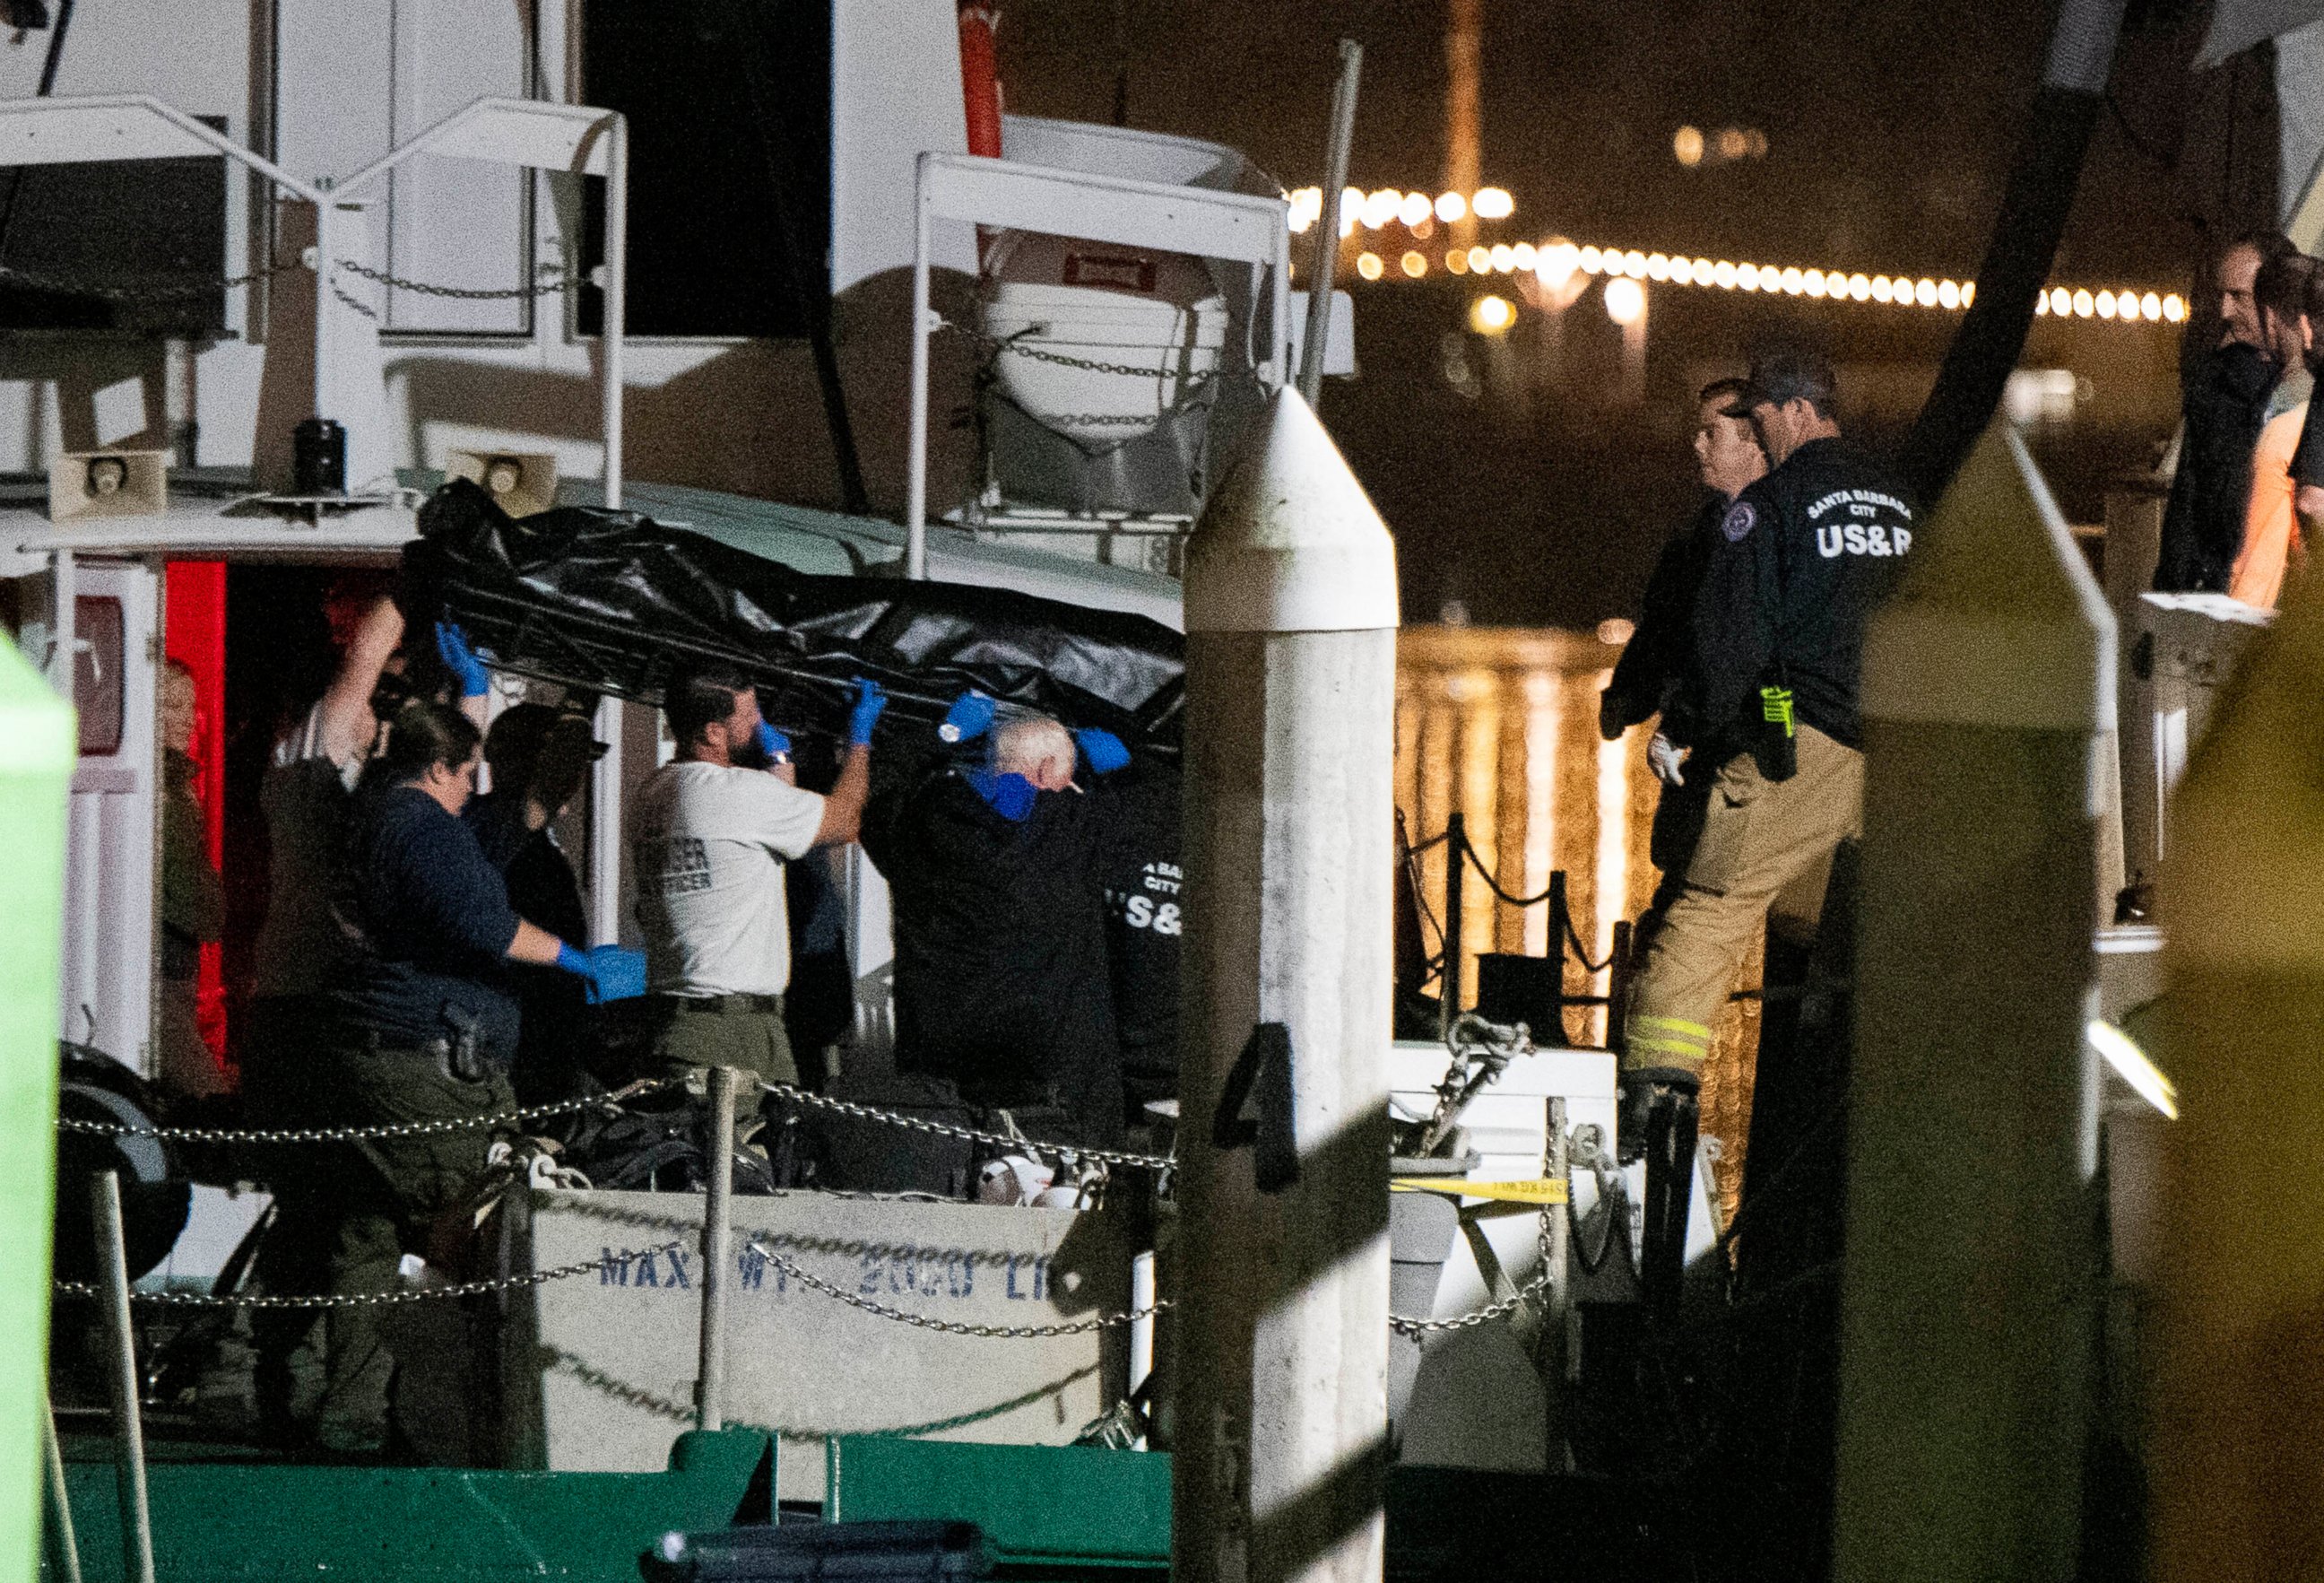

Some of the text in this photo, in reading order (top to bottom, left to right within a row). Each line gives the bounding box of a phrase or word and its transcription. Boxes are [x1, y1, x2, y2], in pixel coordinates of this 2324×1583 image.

[1807, 489, 1912, 520] SANTA BARBARA
[1849, 503, 1876, 518] CITY
